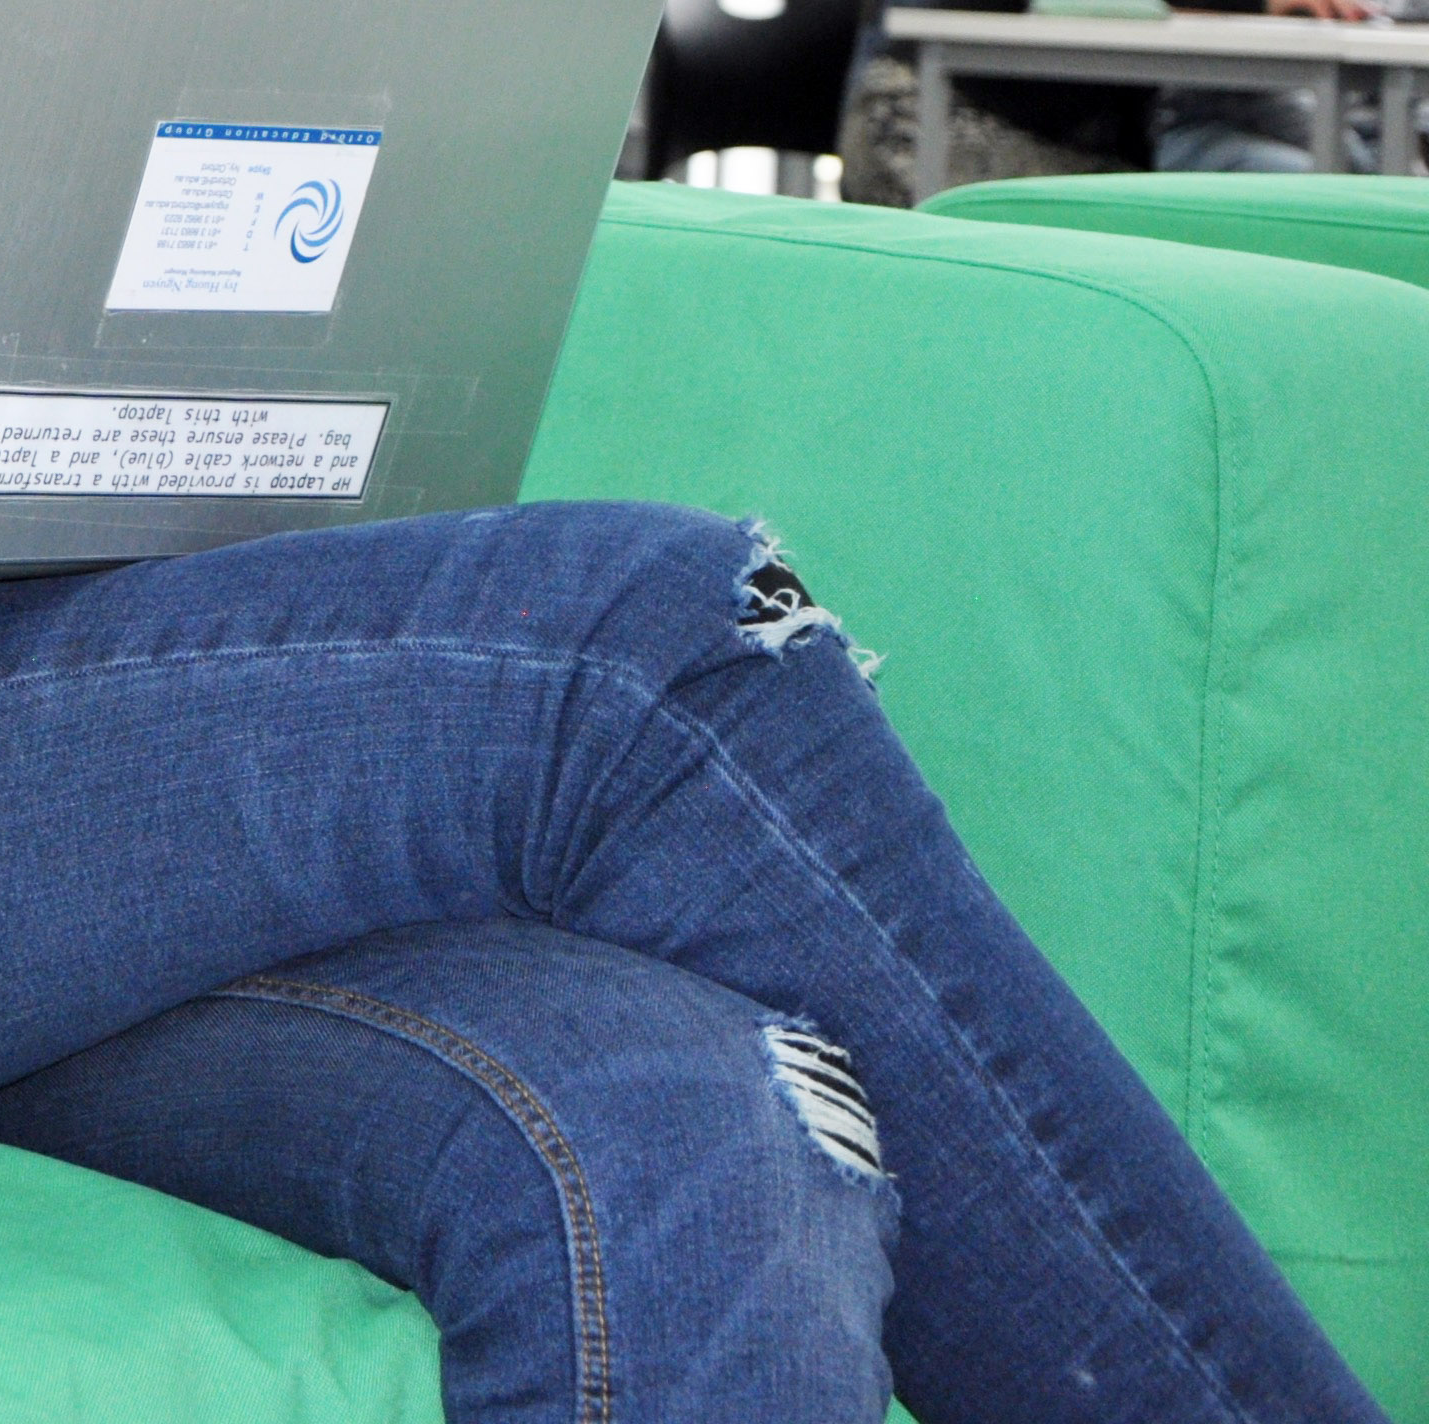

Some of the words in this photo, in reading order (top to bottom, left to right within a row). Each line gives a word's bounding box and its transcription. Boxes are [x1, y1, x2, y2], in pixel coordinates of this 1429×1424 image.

[164, 124, 213, 138] Group
[225, 128, 310, 141] Education
[320, 131, 374, 144] Ozford
[112, 404, 172, 425] laptop.
[185, 408, 221, 425] this
[232, 410, 268, 427] with
[1, 427, 82, 443] returned
[93, 429, 121, 442] are
[130, 430, 175, 446] these
[187, 431, 243, 444] ensure
[252, 432, 306, 448] Please
[319, 430, 351, 449] bag.
[51, 450, 60, 463] a
[69, 451, 100, 467] and
[113, 448, 173, 469] (blue),
[185, 453, 232, 470] cable
[241, 455, 304, 469] network
[314, 455, 323, 468] a
[330, 455, 358, 471] and
[93, 474, 102, 486] a
[112, 475, 149, 490] with
[157, 473, 235, 492] provided
[243, 476, 260, 493] is
[271, 473, 324, 491] Laptop
[332, 476, 352, 491] HP
